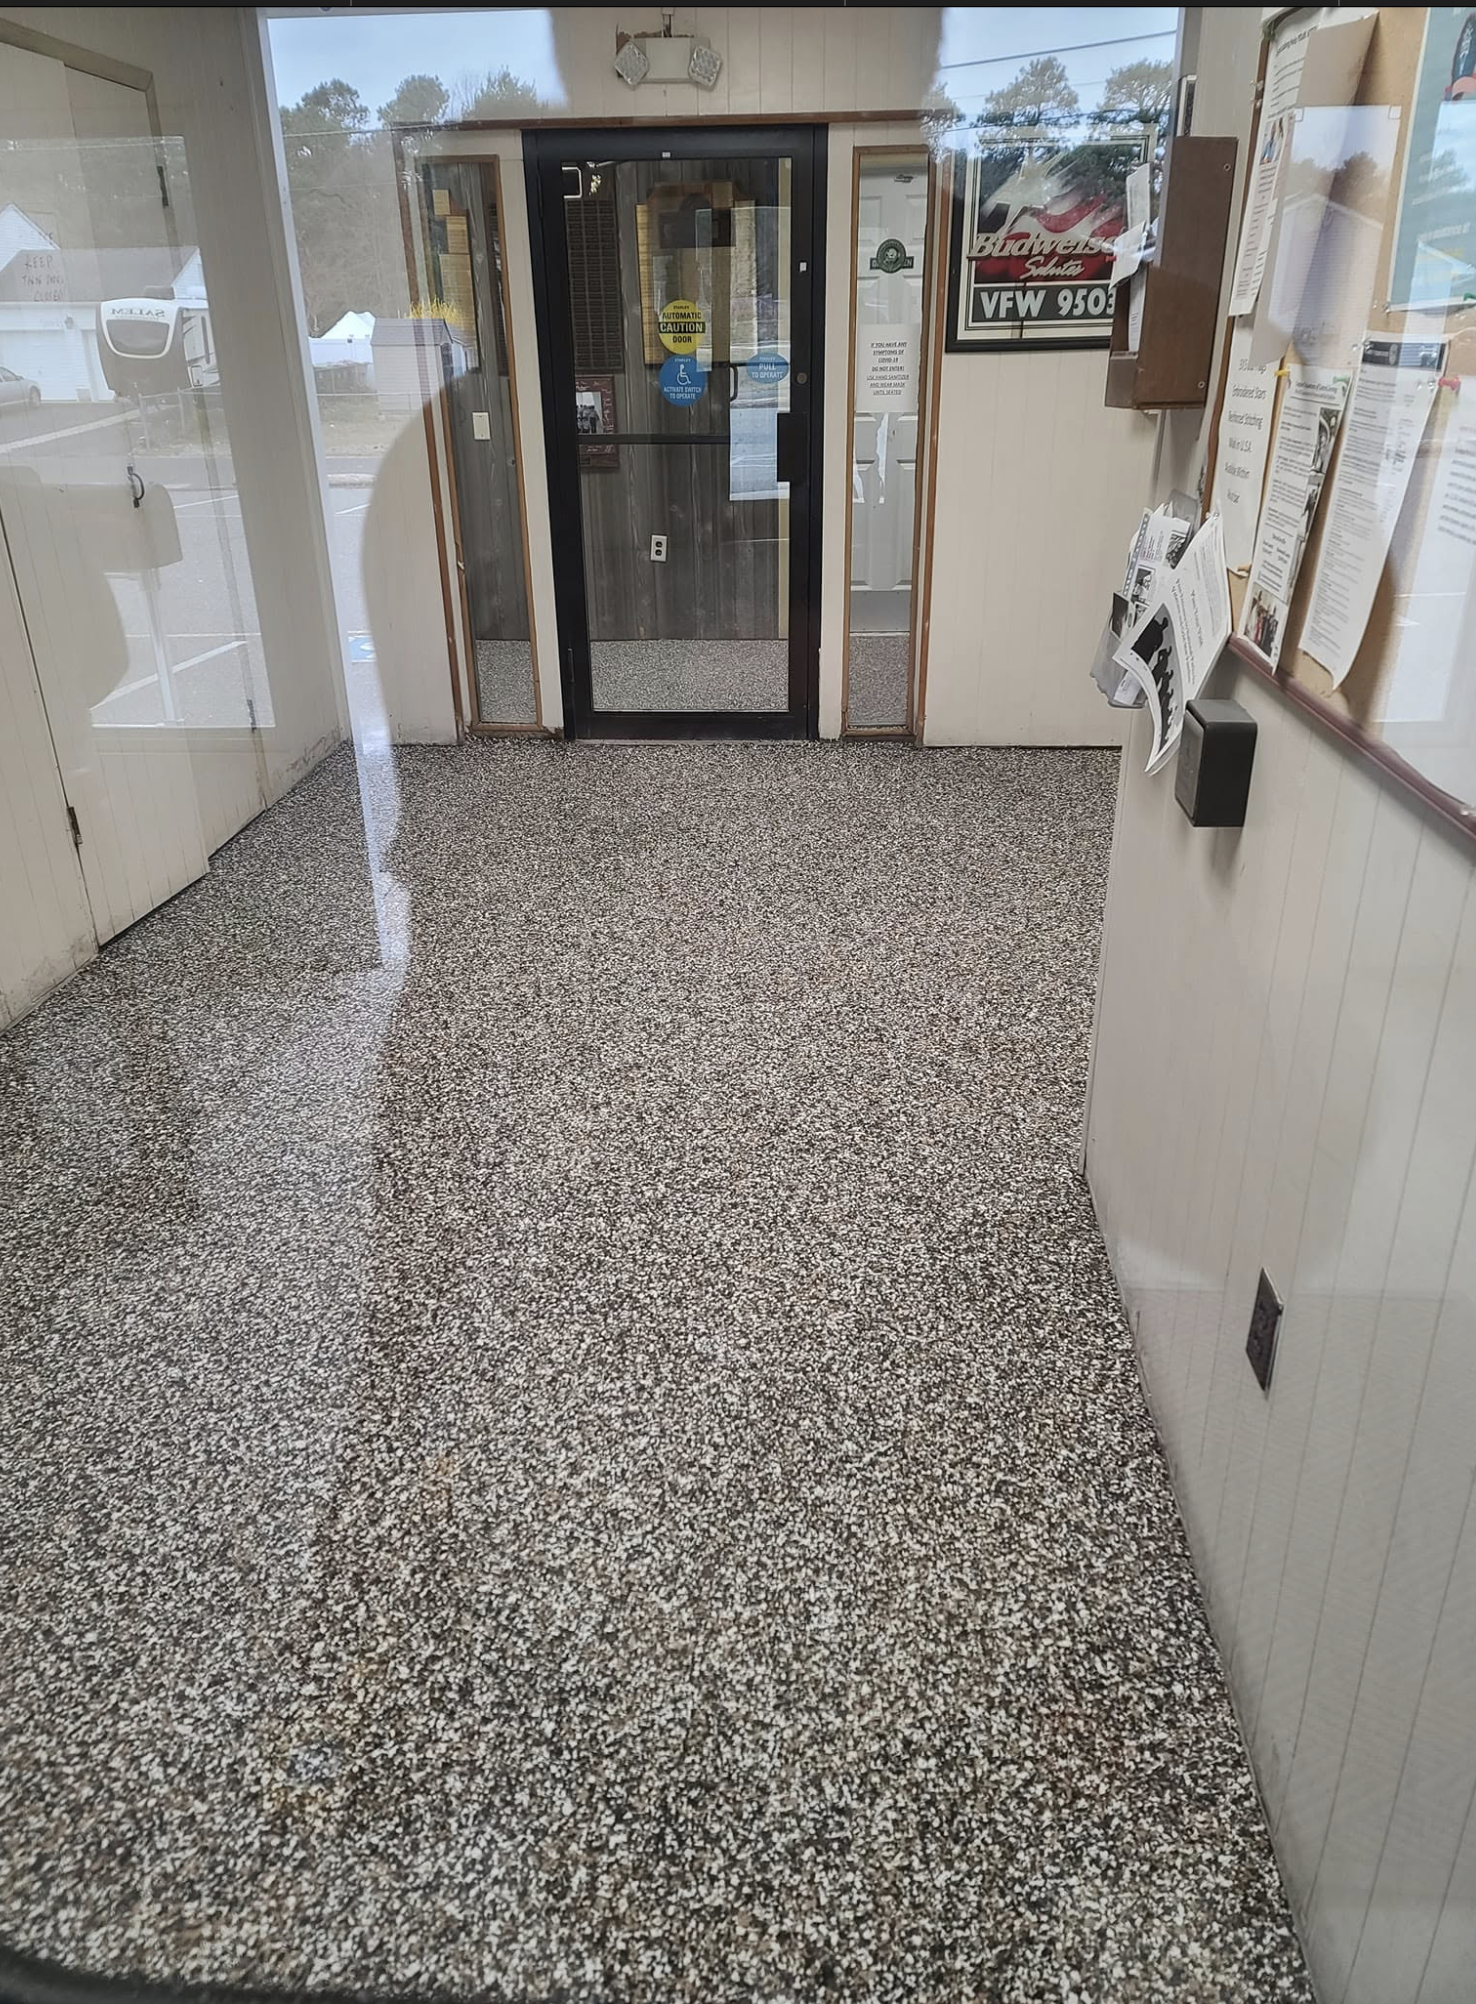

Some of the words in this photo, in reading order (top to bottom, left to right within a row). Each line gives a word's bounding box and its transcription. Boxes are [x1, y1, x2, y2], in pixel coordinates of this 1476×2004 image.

[967, 232, 1119, 258] Budweise
[24, 254, 53, 270] KEEP
[1019, 255, 1085, 279] Salutes
[980, 289, 1046, 319] VFW
[1057, 287, 1117, 316] 9503
[662, 312, 702, 320] AUTOMATIC
[660, 322, 703, 332] CAUTION
[672, 335, 692, 344] DOOR
[759, 363, 777, 371] PULL
[760, 371, 784, 379] OPERATE
